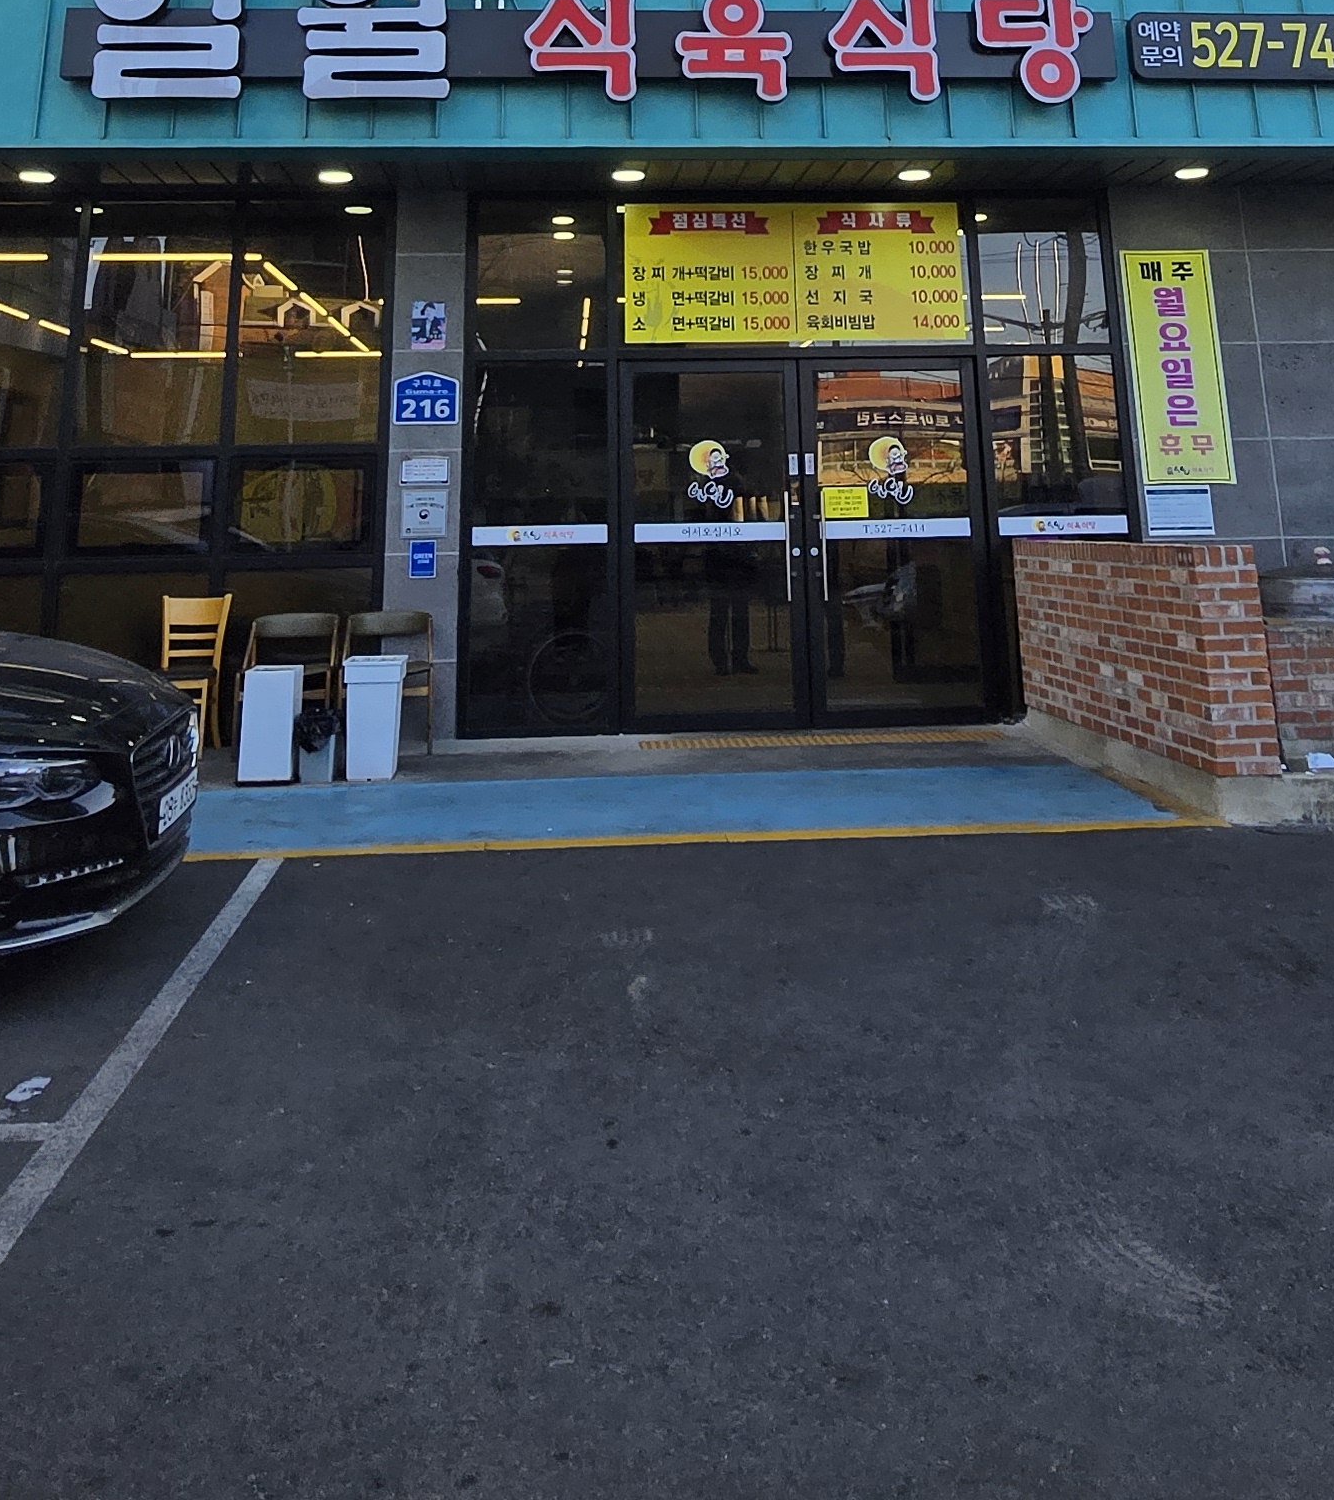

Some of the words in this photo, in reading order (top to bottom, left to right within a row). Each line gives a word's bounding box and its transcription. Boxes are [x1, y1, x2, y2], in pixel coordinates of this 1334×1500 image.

[1138, 21, 1181, 42] 예약
[1141, 45, 1183, 67] 문의
[908, 240, 955, 255] 10,000
[741, 266, 789, 281] 15,000
[910, 265, 956, 280] 10,000
[742, 291, 789, 306] 15,000
[911, 289, 958, 305] 10,000
[743, 316, 790, 331] 15,000
[806, 314, 875, 331] 육회비빔밥
[913, 314, 959, 330] 14,000
[401, 398, 450, 419] 216
